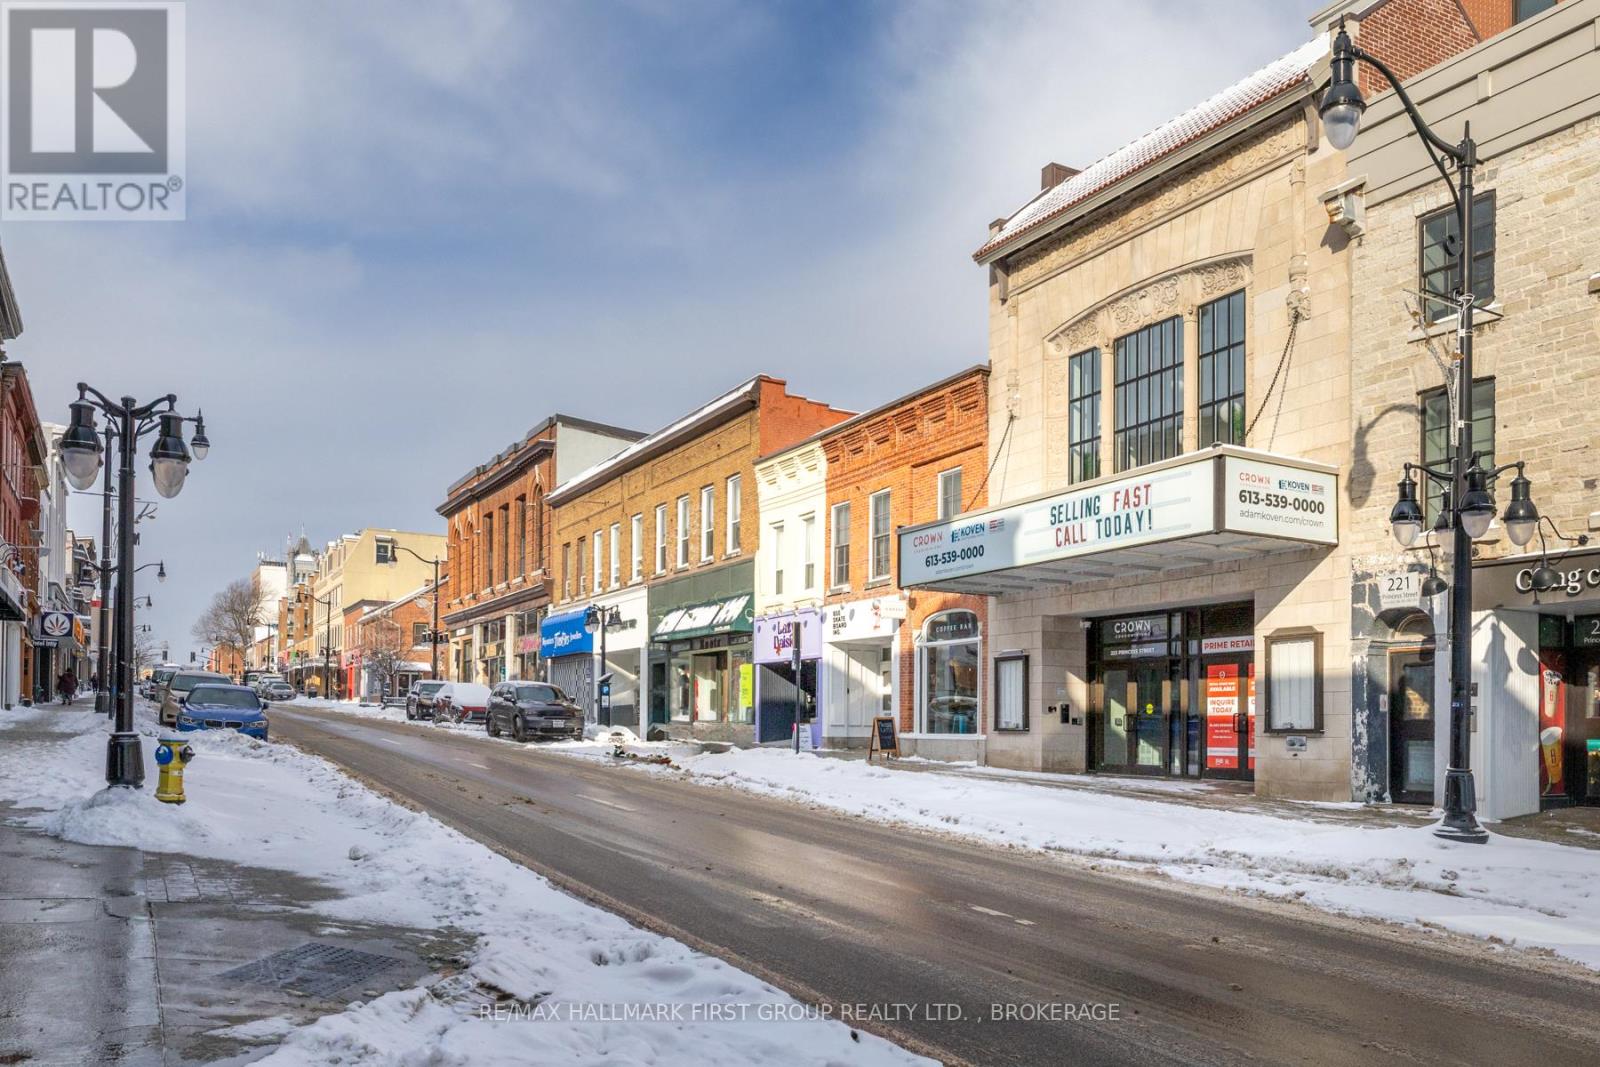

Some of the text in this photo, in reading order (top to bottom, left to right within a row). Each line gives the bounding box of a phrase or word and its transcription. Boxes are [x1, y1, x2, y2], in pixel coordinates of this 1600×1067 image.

[1239, 472, 1271, 485] CROWN
[1287, 480, 1309, 491] KOVEN
[1050, 484, 1151, 526] SELLING FAST
[1239, 489, 1325, 515] 613-539-0000
[1240, 509, 1325, 528] adamkoven.com/crown
[960, 522, 985, 536] KOVEN
[1055, 508, 1152, 547] CALL TODAY!
[913, 531, 943, 548] CROWN
[925, 544, 985, 568] 613-539-0000
[1387, 576, 1410, 591] 221
[1403, 591, 1418, 599] Street
[777, 621, 793, 635] Laz
[935, 622, 973, 633] COFFEE BAR
[1114, 620, 1151, 633] CROWN
[1204, 641, 1229, 650] PRIME
